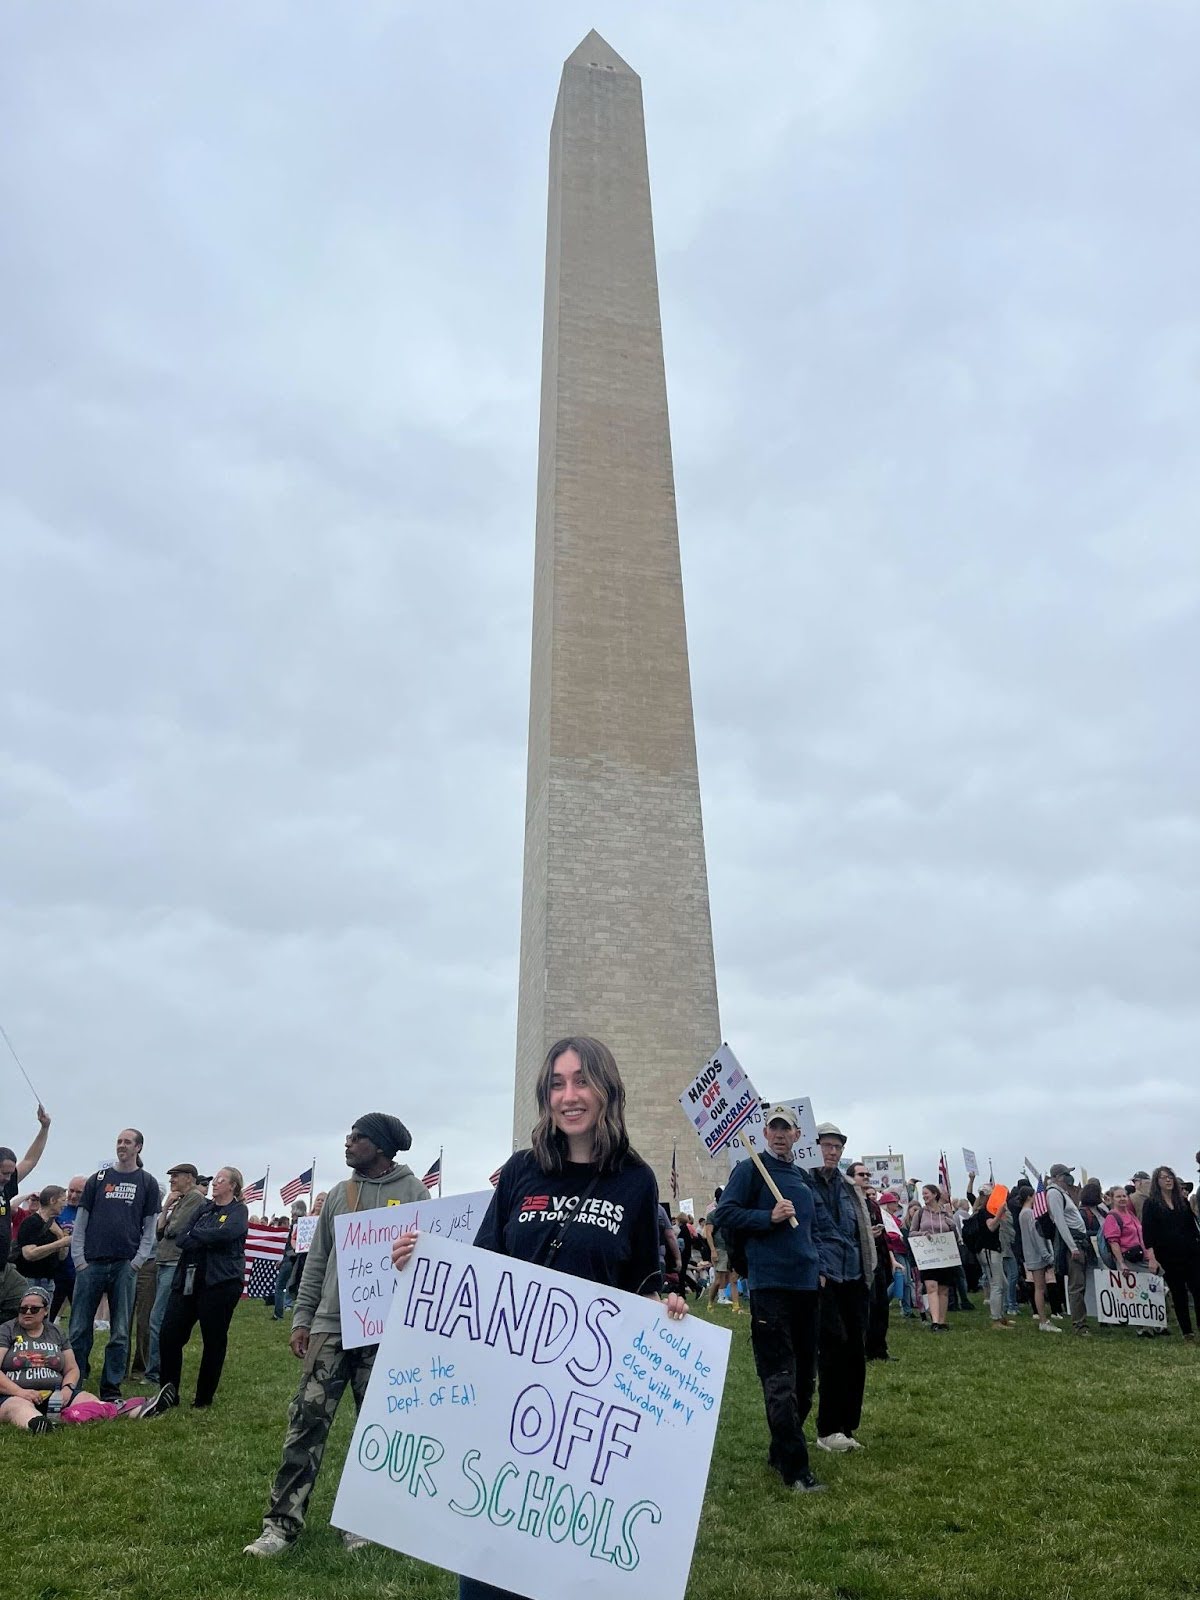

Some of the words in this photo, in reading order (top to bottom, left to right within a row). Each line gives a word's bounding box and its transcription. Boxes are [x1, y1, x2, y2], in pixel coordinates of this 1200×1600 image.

[688, 1059, 722, 1104] HANDS
[702, 1080, 721, 1108] OFF
[704, 1090, 752, 1148] DEMOCRACY
[710, 1098, 728, 1120] OUR
[429, 1217, 442, 1234] is
[446, 1204, 474, 1238] just
[518, 1211, 537, 1223] OF
[539, 1210, 620, 1235] TOMRROW
[552, 1195, 625, 1222] VOTERS
[348, 1257, 373, 1279] the
[1109, 1270, 1136, 1288] NO
[352, 1279, 384, 1303] COAL
[1100, 1289, 1165, 1323] Oligarchs
[1122, 1289, 1134, 1299] to
[404, 1257, 621, 1387] HANDS
[13, 1341, 29, 1352] MY
[33, 1341, 59, 1352] BODY
[652, 1318, 660, 1331] I
[659, 1328, 691, 1360] could
[694, 1350, 711, 1378] be
[6, 1370, 21, 1380] MY
[430, 1355, 455, 1379] the
[633, 1330, 662, 1371] doing
[664, 1364, 714, 1411] anything
[387, 1386, 424, 1414] Dept.
[429, 1386, 446, 1406] of
[451, 1384, 476, 1407] Ed!
[613, 1372, 675, 1427] Saturday...
[623, 1353, 647, 1380] else
[648, 1377, 671, 1401] with
[673, 1398, 694, 1426] my
[510, 1384, 642, 1486] OFF
[358, 1424, 445, 1497] OUR
[448, 1449, 662, 1571] SCHOOLS
